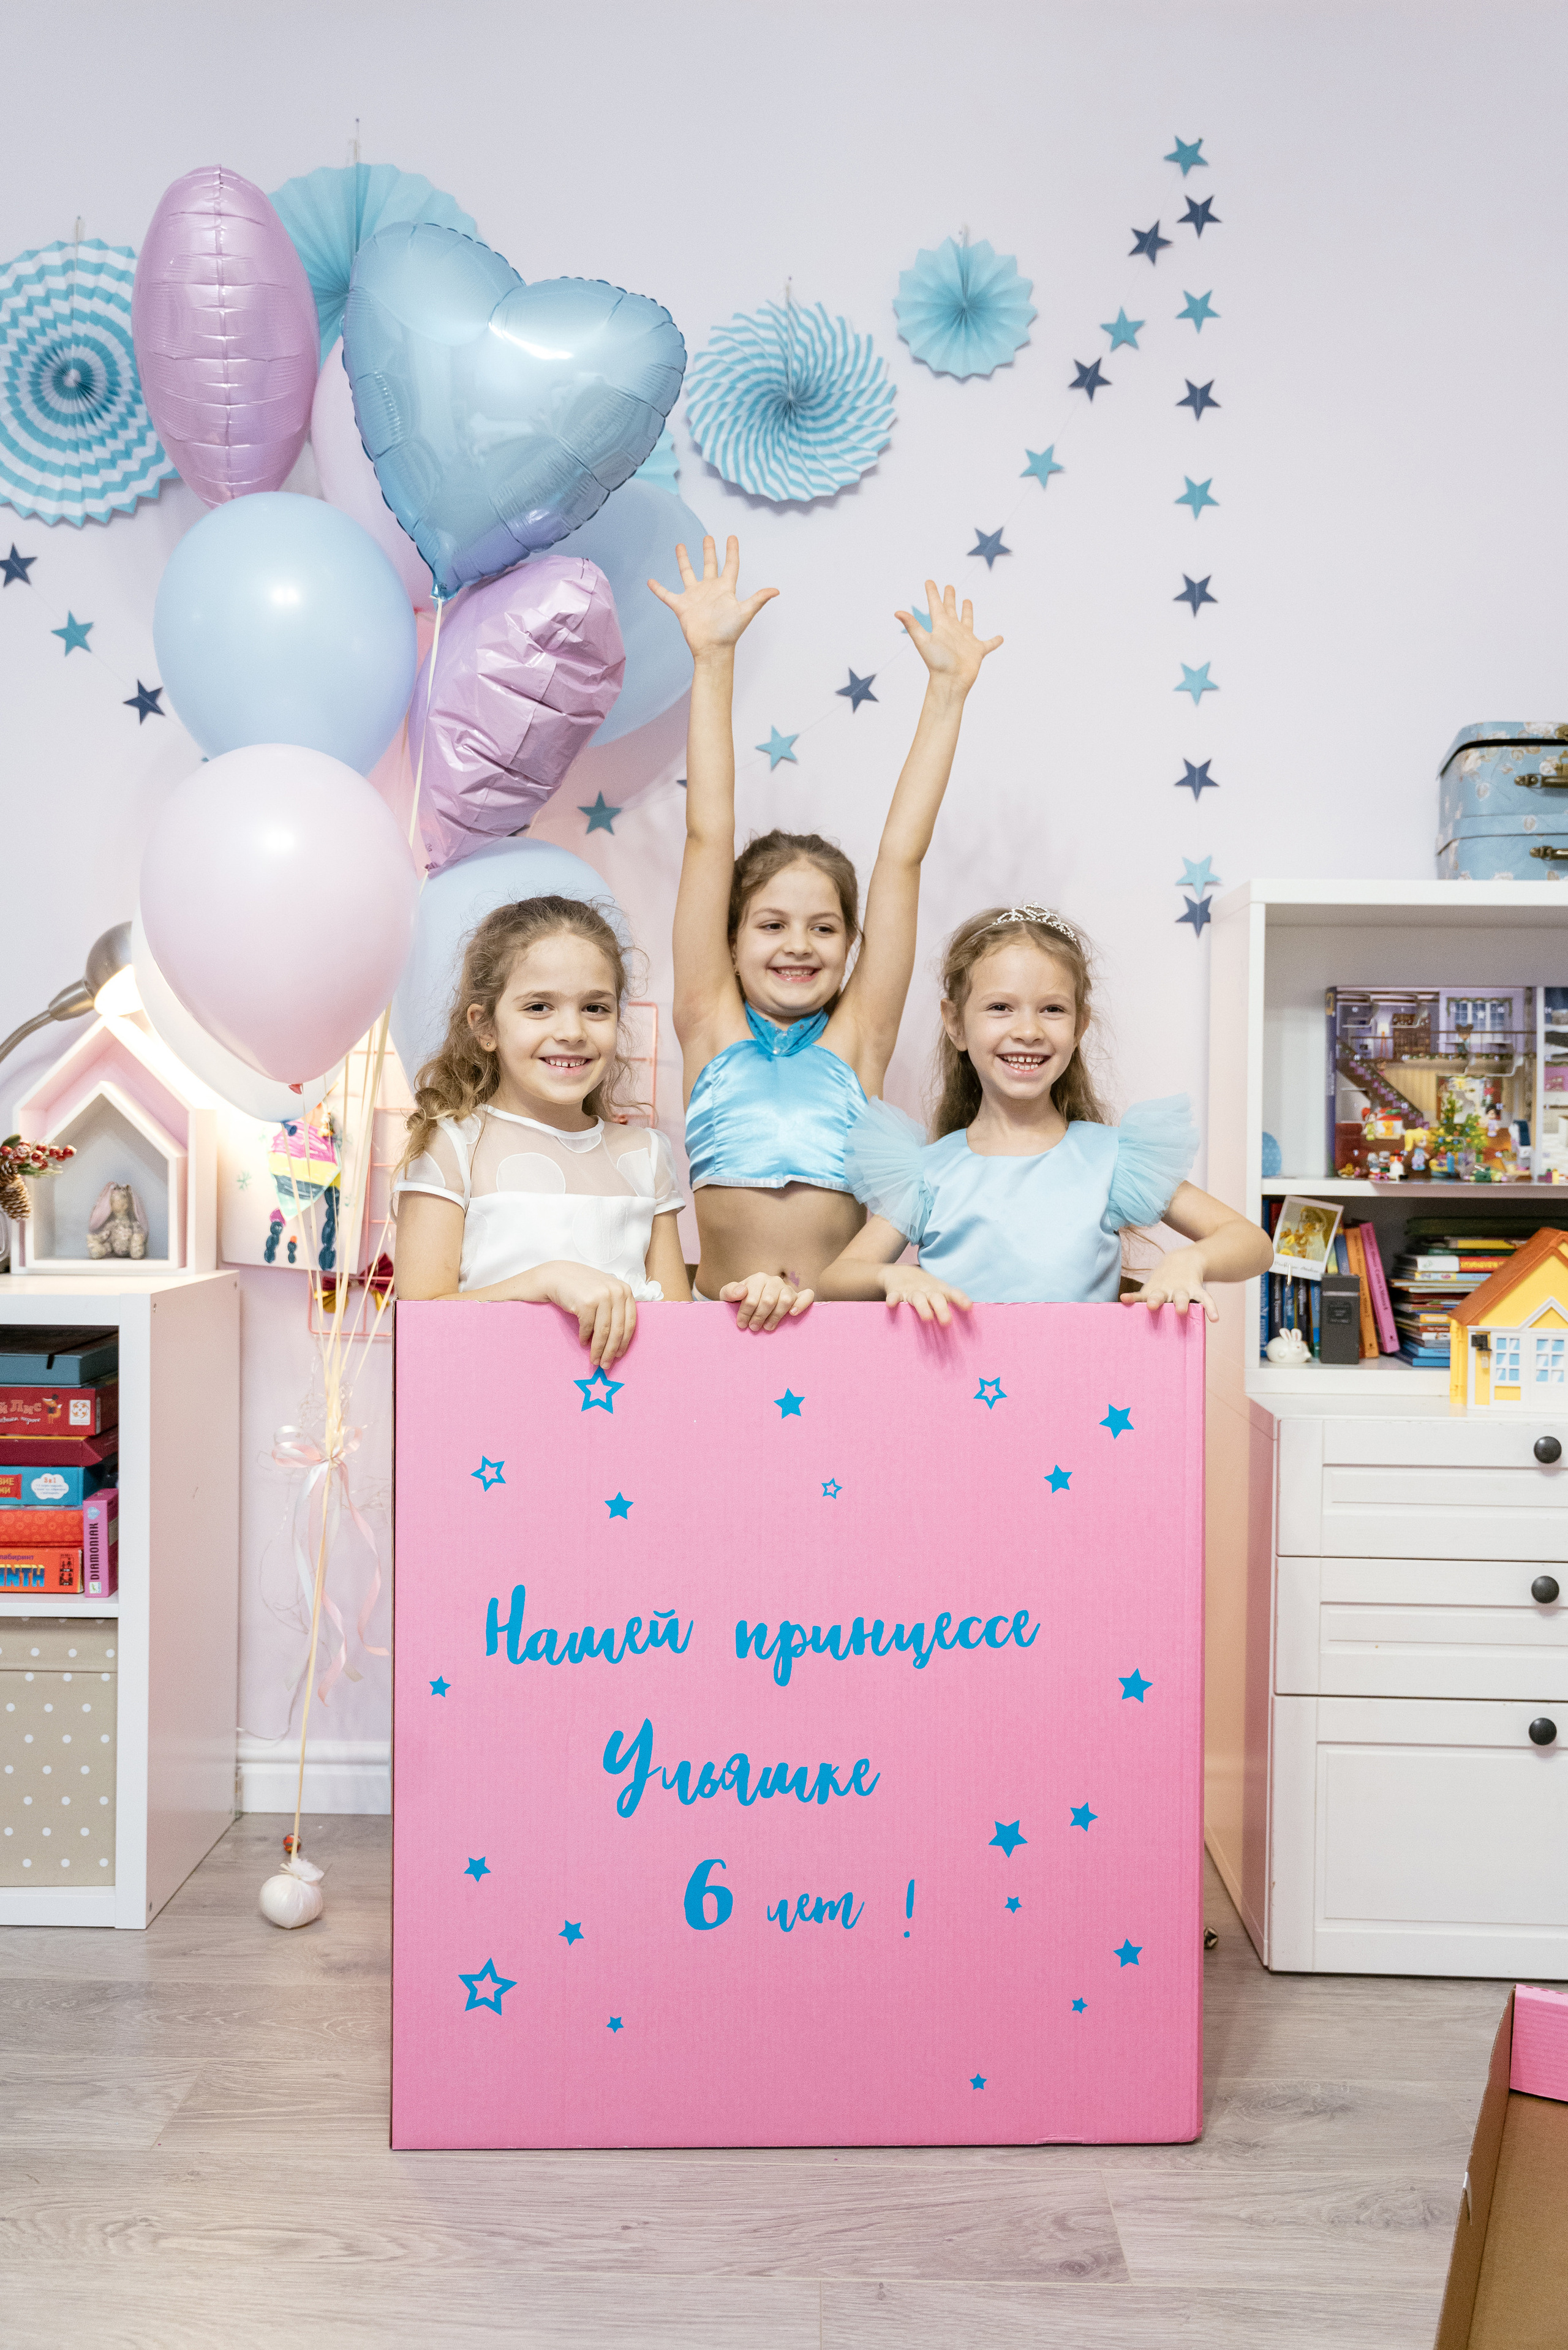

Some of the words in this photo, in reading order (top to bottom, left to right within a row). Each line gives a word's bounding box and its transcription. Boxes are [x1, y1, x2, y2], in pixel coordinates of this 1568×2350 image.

[10, 1399, 42, 1415] Лис
[89, 1521, 100, 1580] DIAMONIAK
[485, 1584, 694, 1666] Нашей
[735, 1609, 1041, 1687] принцессе
[603, 1717, 881, 1819] Ульяшке
[684, 1859, 733, 1930] 6
[767, 1892, 865, 1932] лет
